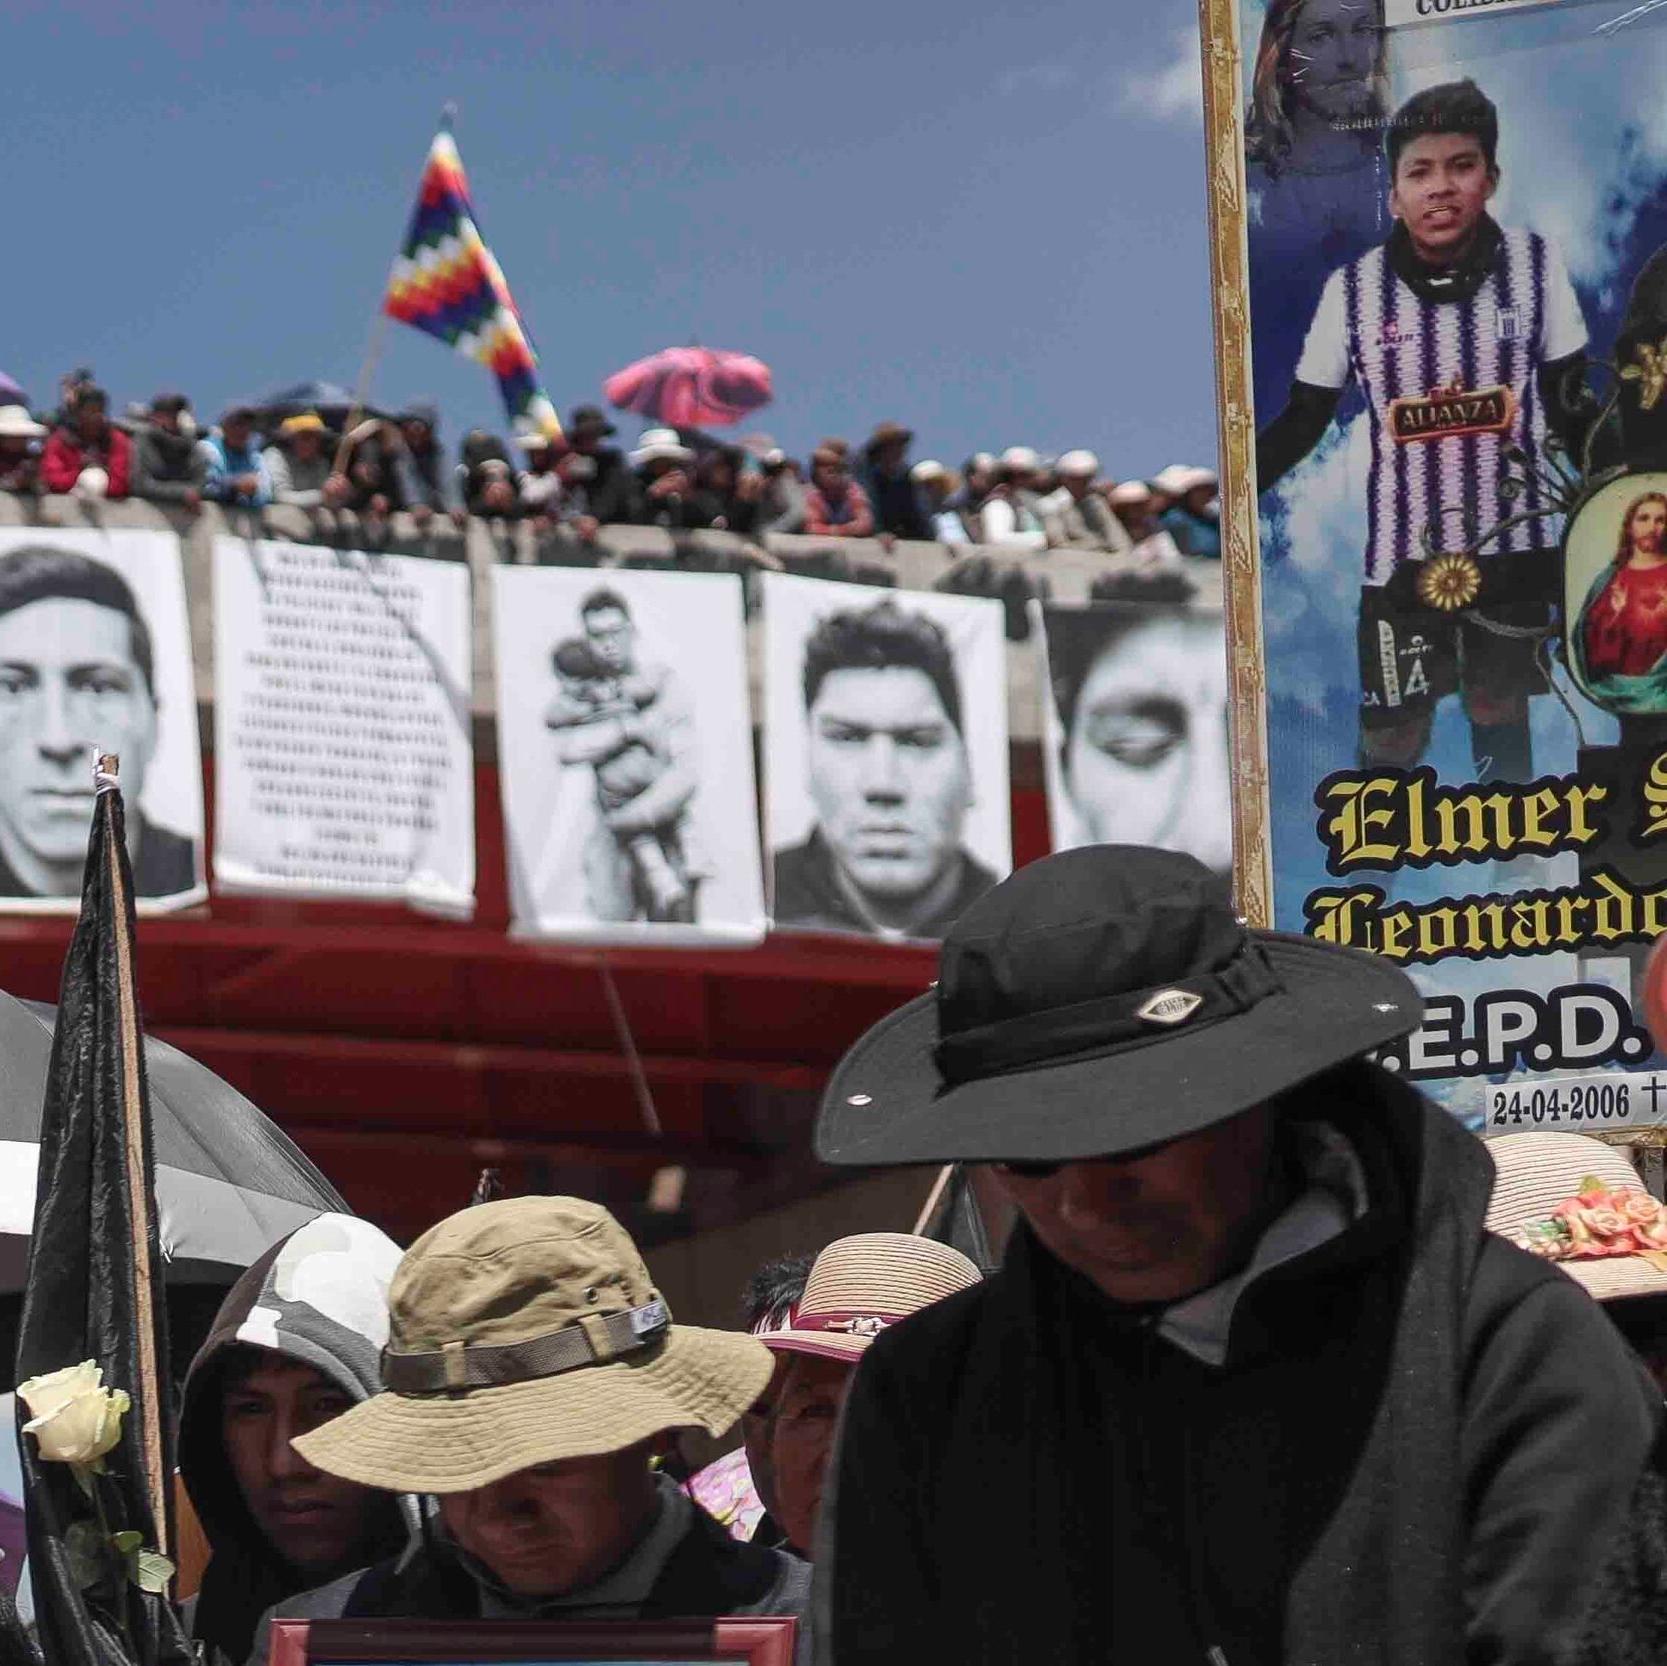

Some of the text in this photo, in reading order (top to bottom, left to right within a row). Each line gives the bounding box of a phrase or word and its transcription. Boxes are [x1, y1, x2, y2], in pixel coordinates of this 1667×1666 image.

[1403, 398, 1499, 428] ALIANZA
[1327, 777, 1608, 866] Elmer
[1369, 994, 1642, 1072] .E.P.D.
[1493, 1083, 1630, 1125] 24-04-2006
